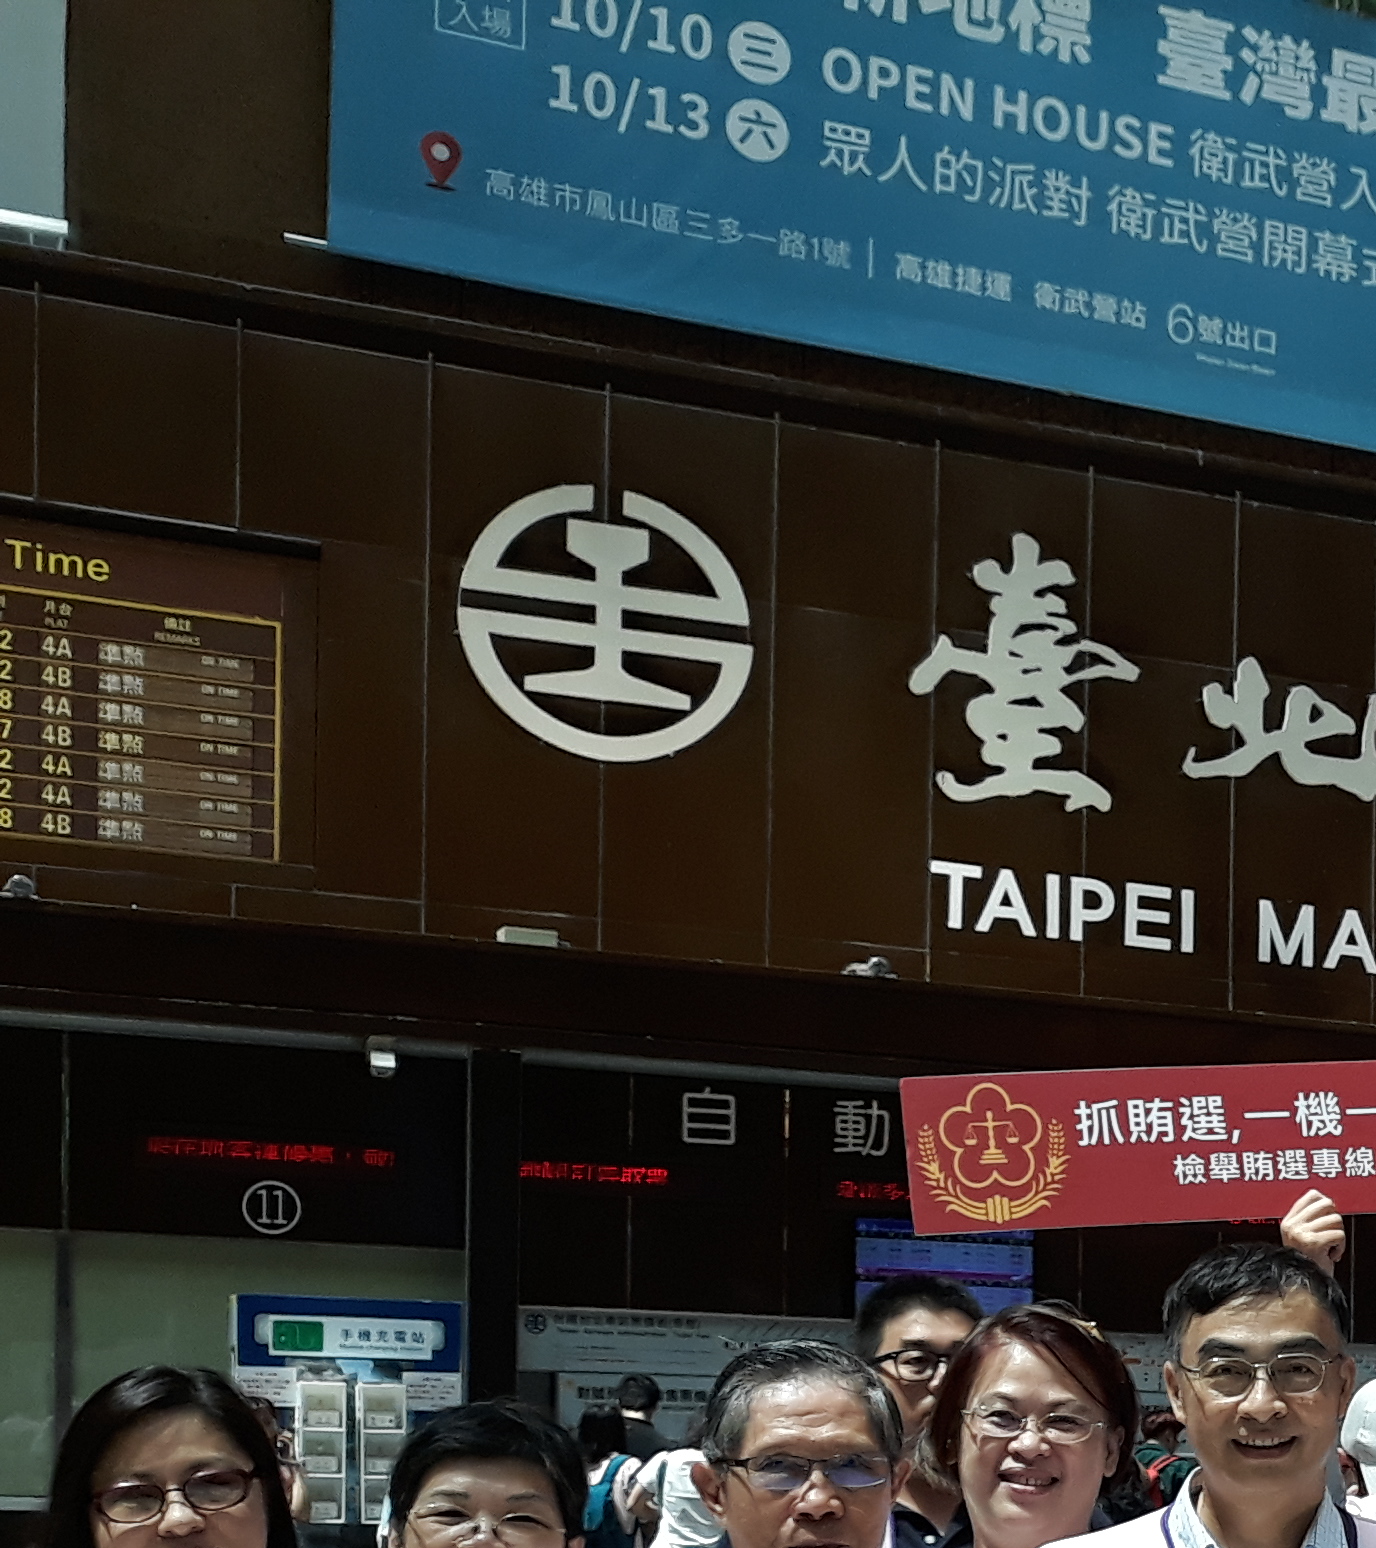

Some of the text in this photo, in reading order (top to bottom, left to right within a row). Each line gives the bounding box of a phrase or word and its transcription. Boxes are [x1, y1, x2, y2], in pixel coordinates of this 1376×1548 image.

[550, 0, 714, 62] 10/10
[821, 46, 976, 123] OPEN
[992, 84, 1177, 168] HOUSE
[547, 63, 712, 141] 10/13
[819, 119, 1094, 228] 眾人的派對
[484, 167, 1278, 357] 高雄市鳳山區三多一路1號 高雄捷運 衛武營站 6號出口
[3, 538, 111, 583] Time
[41, 635, 73, 660] 4A
[41, 665, 73, 688] 4B
[41, 694, 73, 718] 4A
[41, 724, 73, 748] 4B
[41, 754, 73, 777] 4A
[41, 783, 73, 807] 4A
[41, 812, 73, 836] 4B
[929, 857, 1196, 954] TAIPEI
[1172, 1146, 1376, 1187] 檢舉賄選專線
